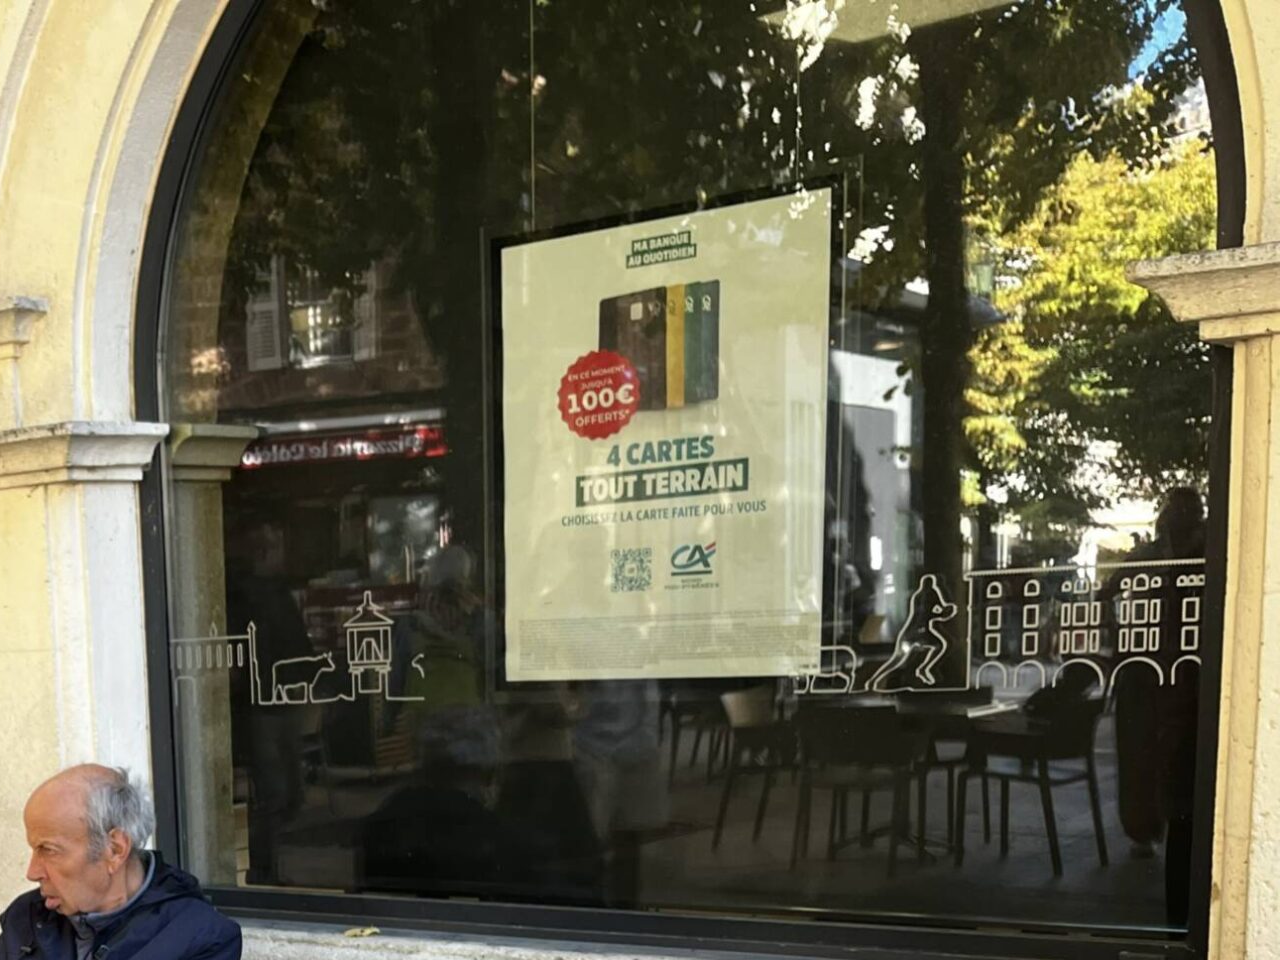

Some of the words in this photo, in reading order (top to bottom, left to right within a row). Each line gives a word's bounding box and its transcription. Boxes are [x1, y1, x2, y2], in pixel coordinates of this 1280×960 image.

[633, 241, 648, 252] MA
[650, 233, 690, 248] BANQUE
[629, 256, 642, 267] AU
[643, 246, 695, 264] QUOTIDIEN
[568, 383, 634, 414] 100€
[607, 444, 621, 467] 4
[626, 435, 715, 466] CARTES
[580, 476, 638, 503] TOUT
[642, 463, 744, 496] TERRAIN
[621, 511, 634, 523] LA
[636, 508, 669, 522] CARTE
[672, 505, 701, 518] FAITE
[703, 502, 734, 516] POUR
[737, 500, 767, 513] VOUS
